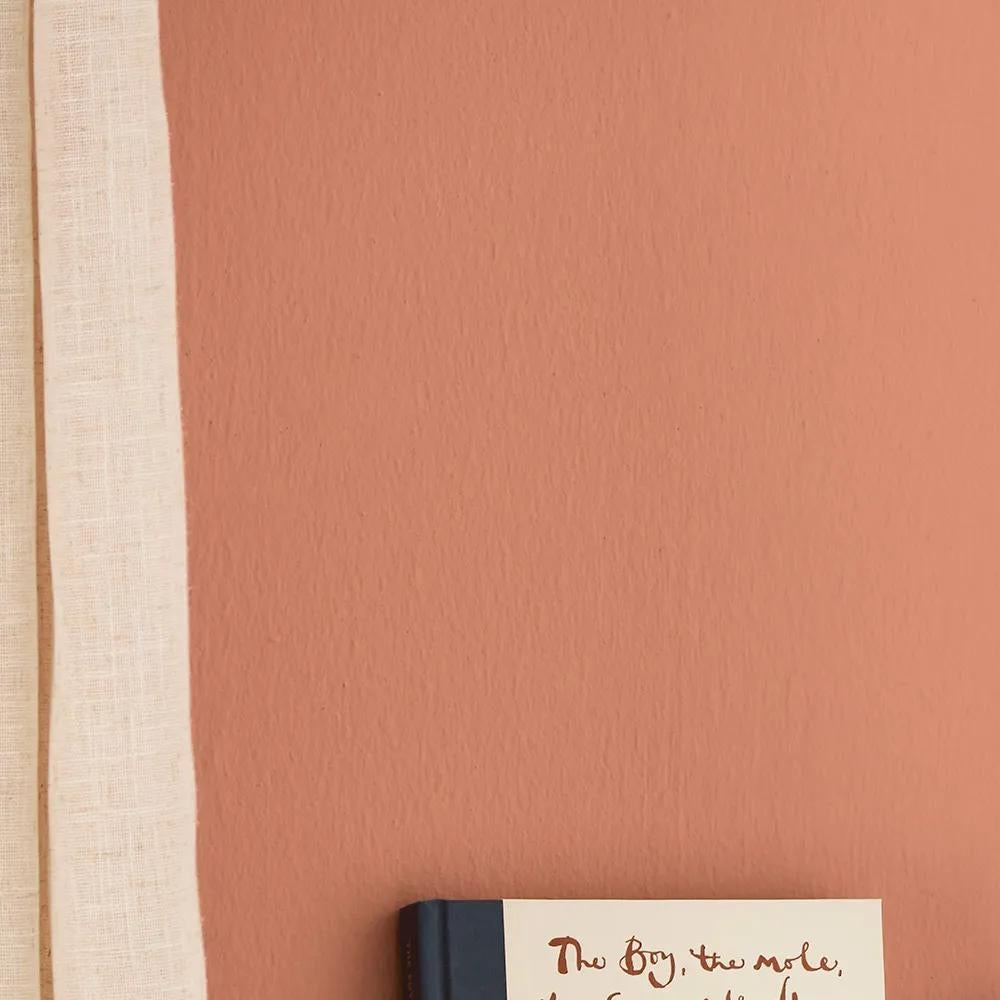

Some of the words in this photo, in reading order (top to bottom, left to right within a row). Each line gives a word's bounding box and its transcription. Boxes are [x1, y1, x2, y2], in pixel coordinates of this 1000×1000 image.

[548, 936, 606, 975] The
[619, 935, 686, 988] Boy,
[689, 944, 745, 972] the
